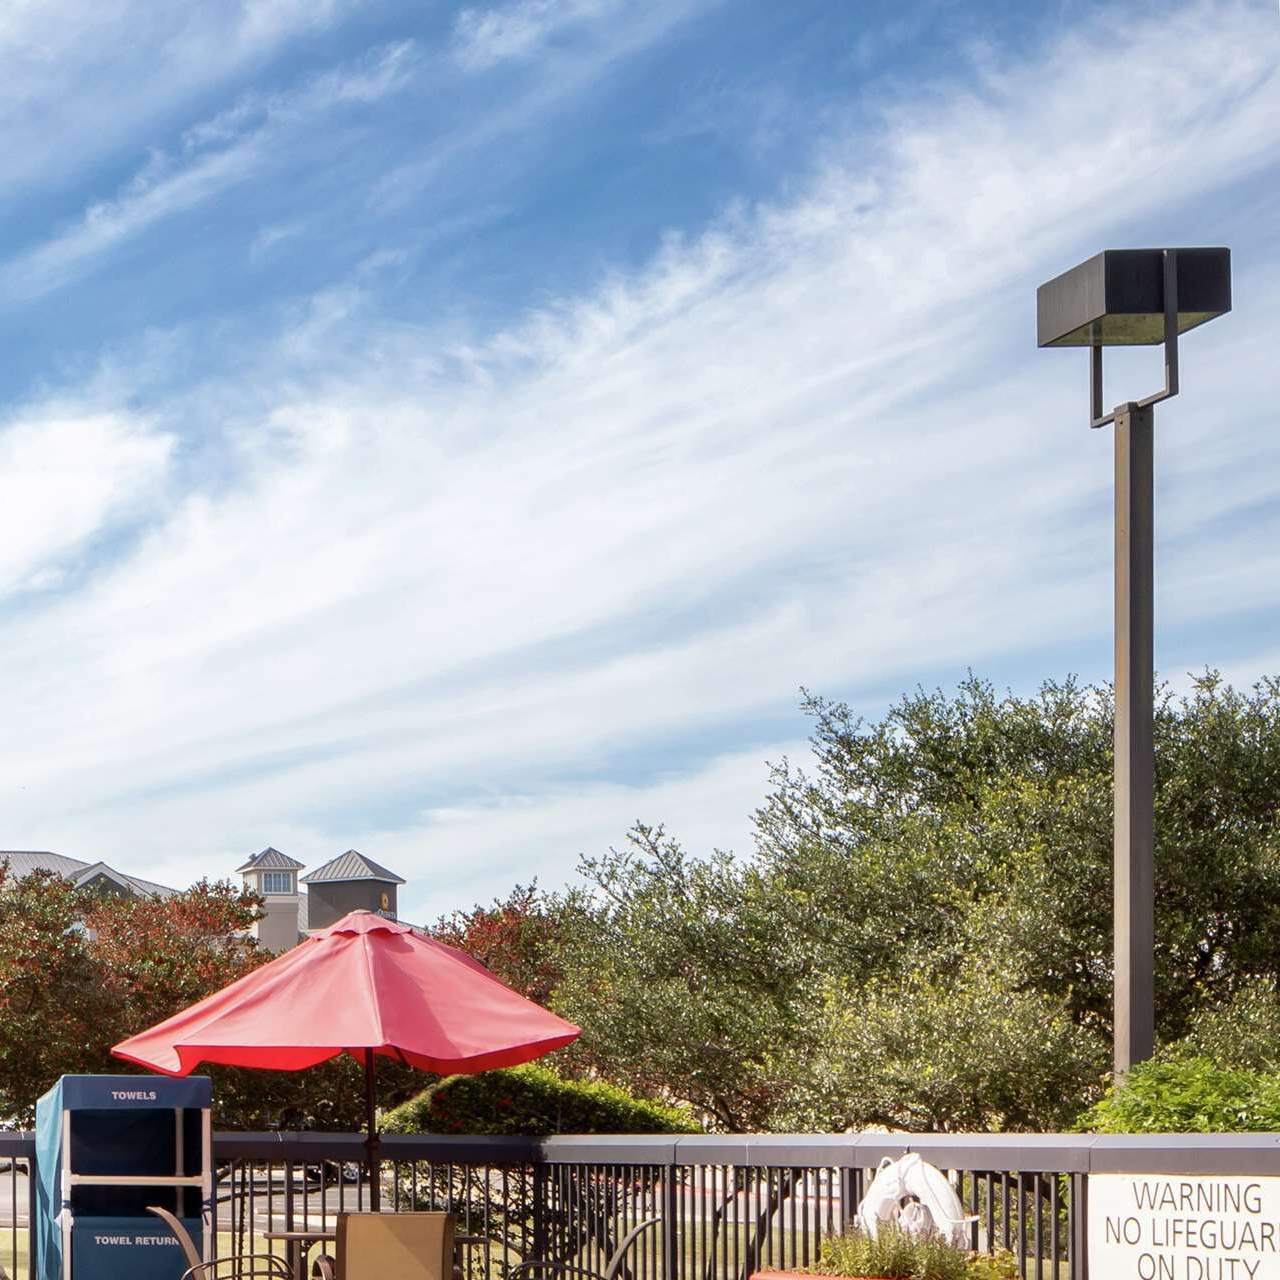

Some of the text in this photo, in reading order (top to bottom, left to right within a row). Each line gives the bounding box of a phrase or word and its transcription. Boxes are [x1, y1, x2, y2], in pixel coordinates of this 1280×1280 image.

[111, 1091, 157, 1100] TOWELS
[1133, 1182, 1262, 1214] WARNING
[95, 1236, 180, 1246] TOWEL RETURN
[1106, 1216, 1280, 1252] NO LIFEGUAR
